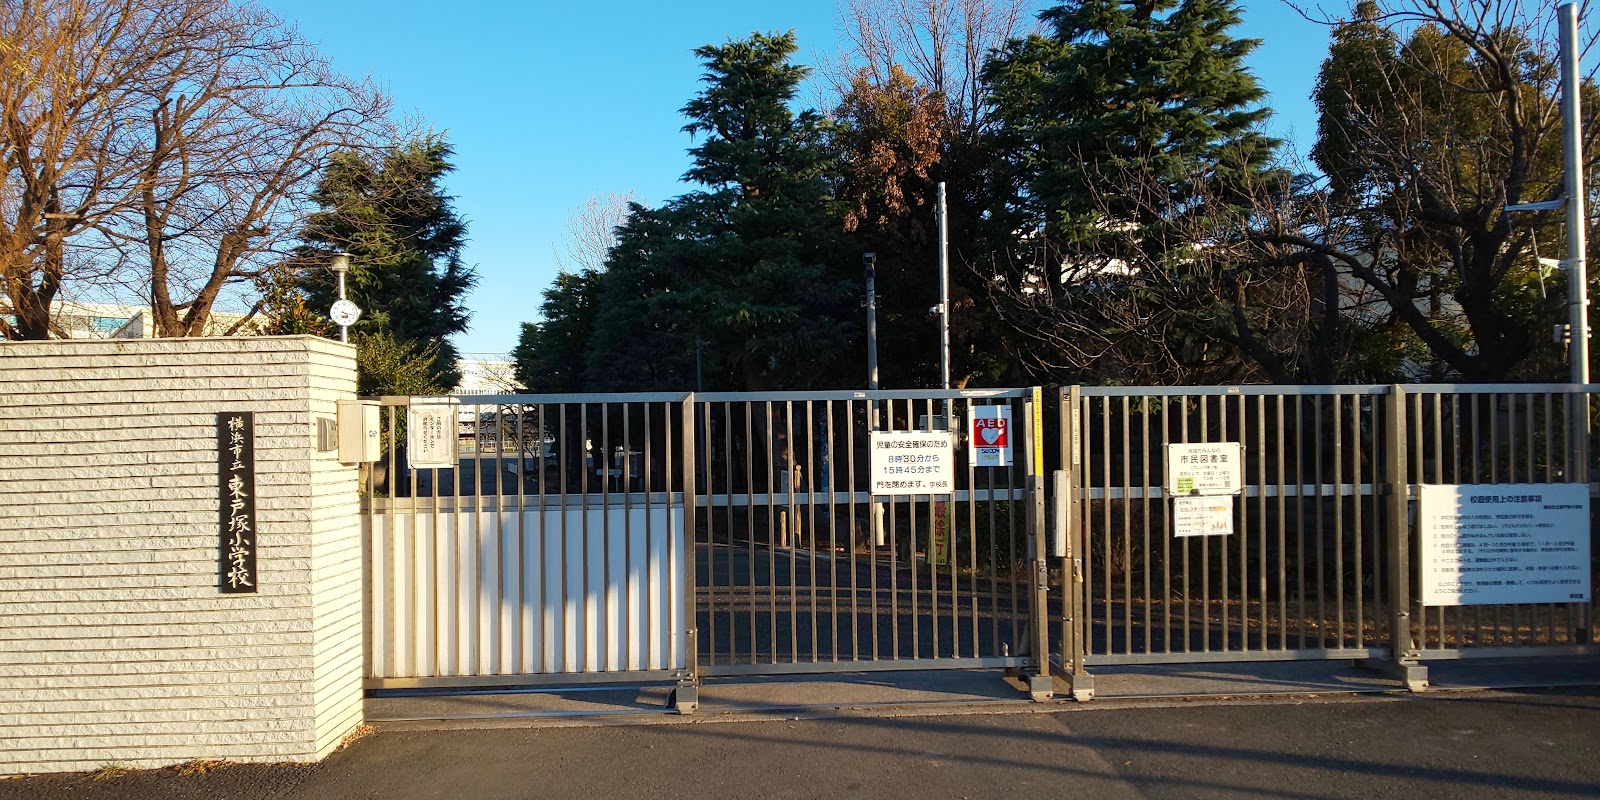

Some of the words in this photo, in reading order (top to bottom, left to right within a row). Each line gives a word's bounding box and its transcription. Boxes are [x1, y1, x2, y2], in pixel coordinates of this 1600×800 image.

[976, 419, 1006, 428] AED
[228, 416, 245, 471] 横浜市立
[876, 440, 948, 449] 児童の安全確保のため
[888, 454, 940, 463] 8時30分から
[1180, 454, 1228, 464] 市民図書室
[883, 465, 940, 474] 15時45分まで
[1470, 495, 1542, 503] 校庭使用上の注意事項
[227, 474, 253, 588] 東戸塚小学校
